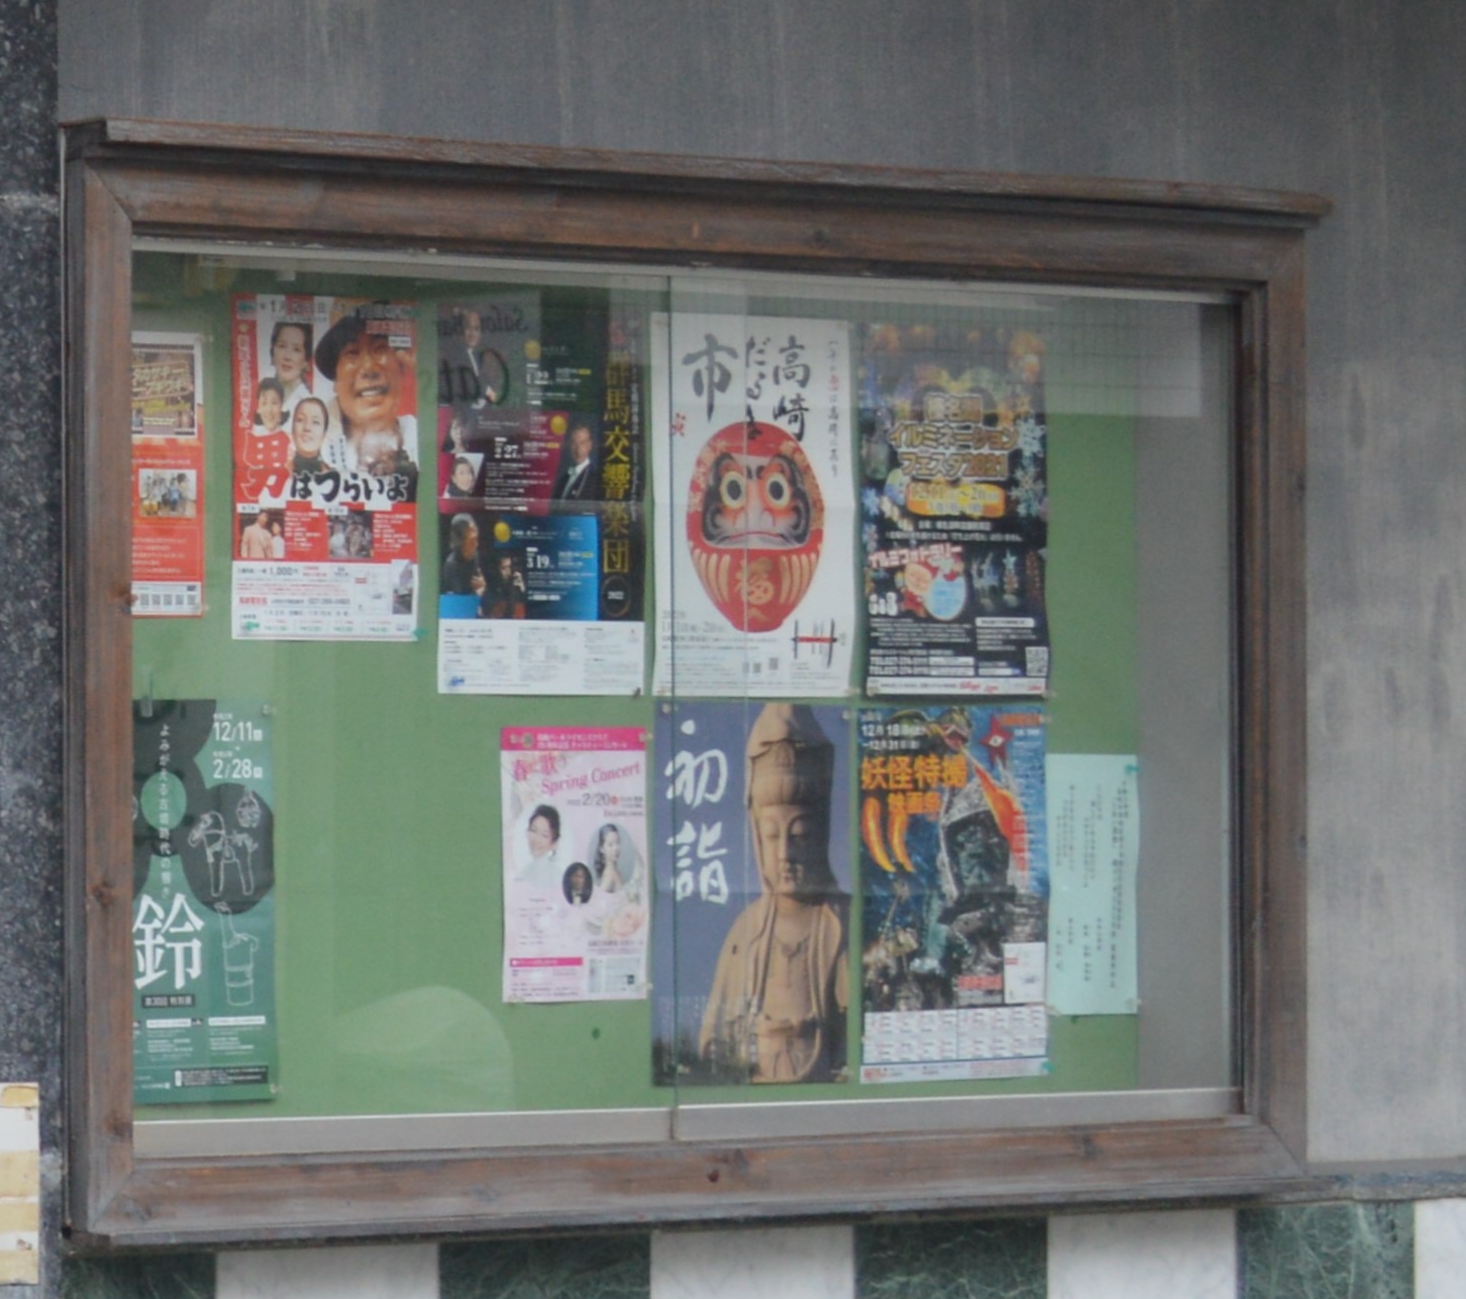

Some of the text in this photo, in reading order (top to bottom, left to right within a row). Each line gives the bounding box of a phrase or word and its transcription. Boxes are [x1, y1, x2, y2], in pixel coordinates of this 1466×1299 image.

[887, 422, 1021, 450] イルミネーション
[241, 427, 411, 502] 男はつらいよ
[541, 761, 641, 797] Spring Concert
[861, 753, 969, 790] 妖怪特撮
[664, 719, 729, 905] 初詣
[132, 892, 205, 990] 鈴
